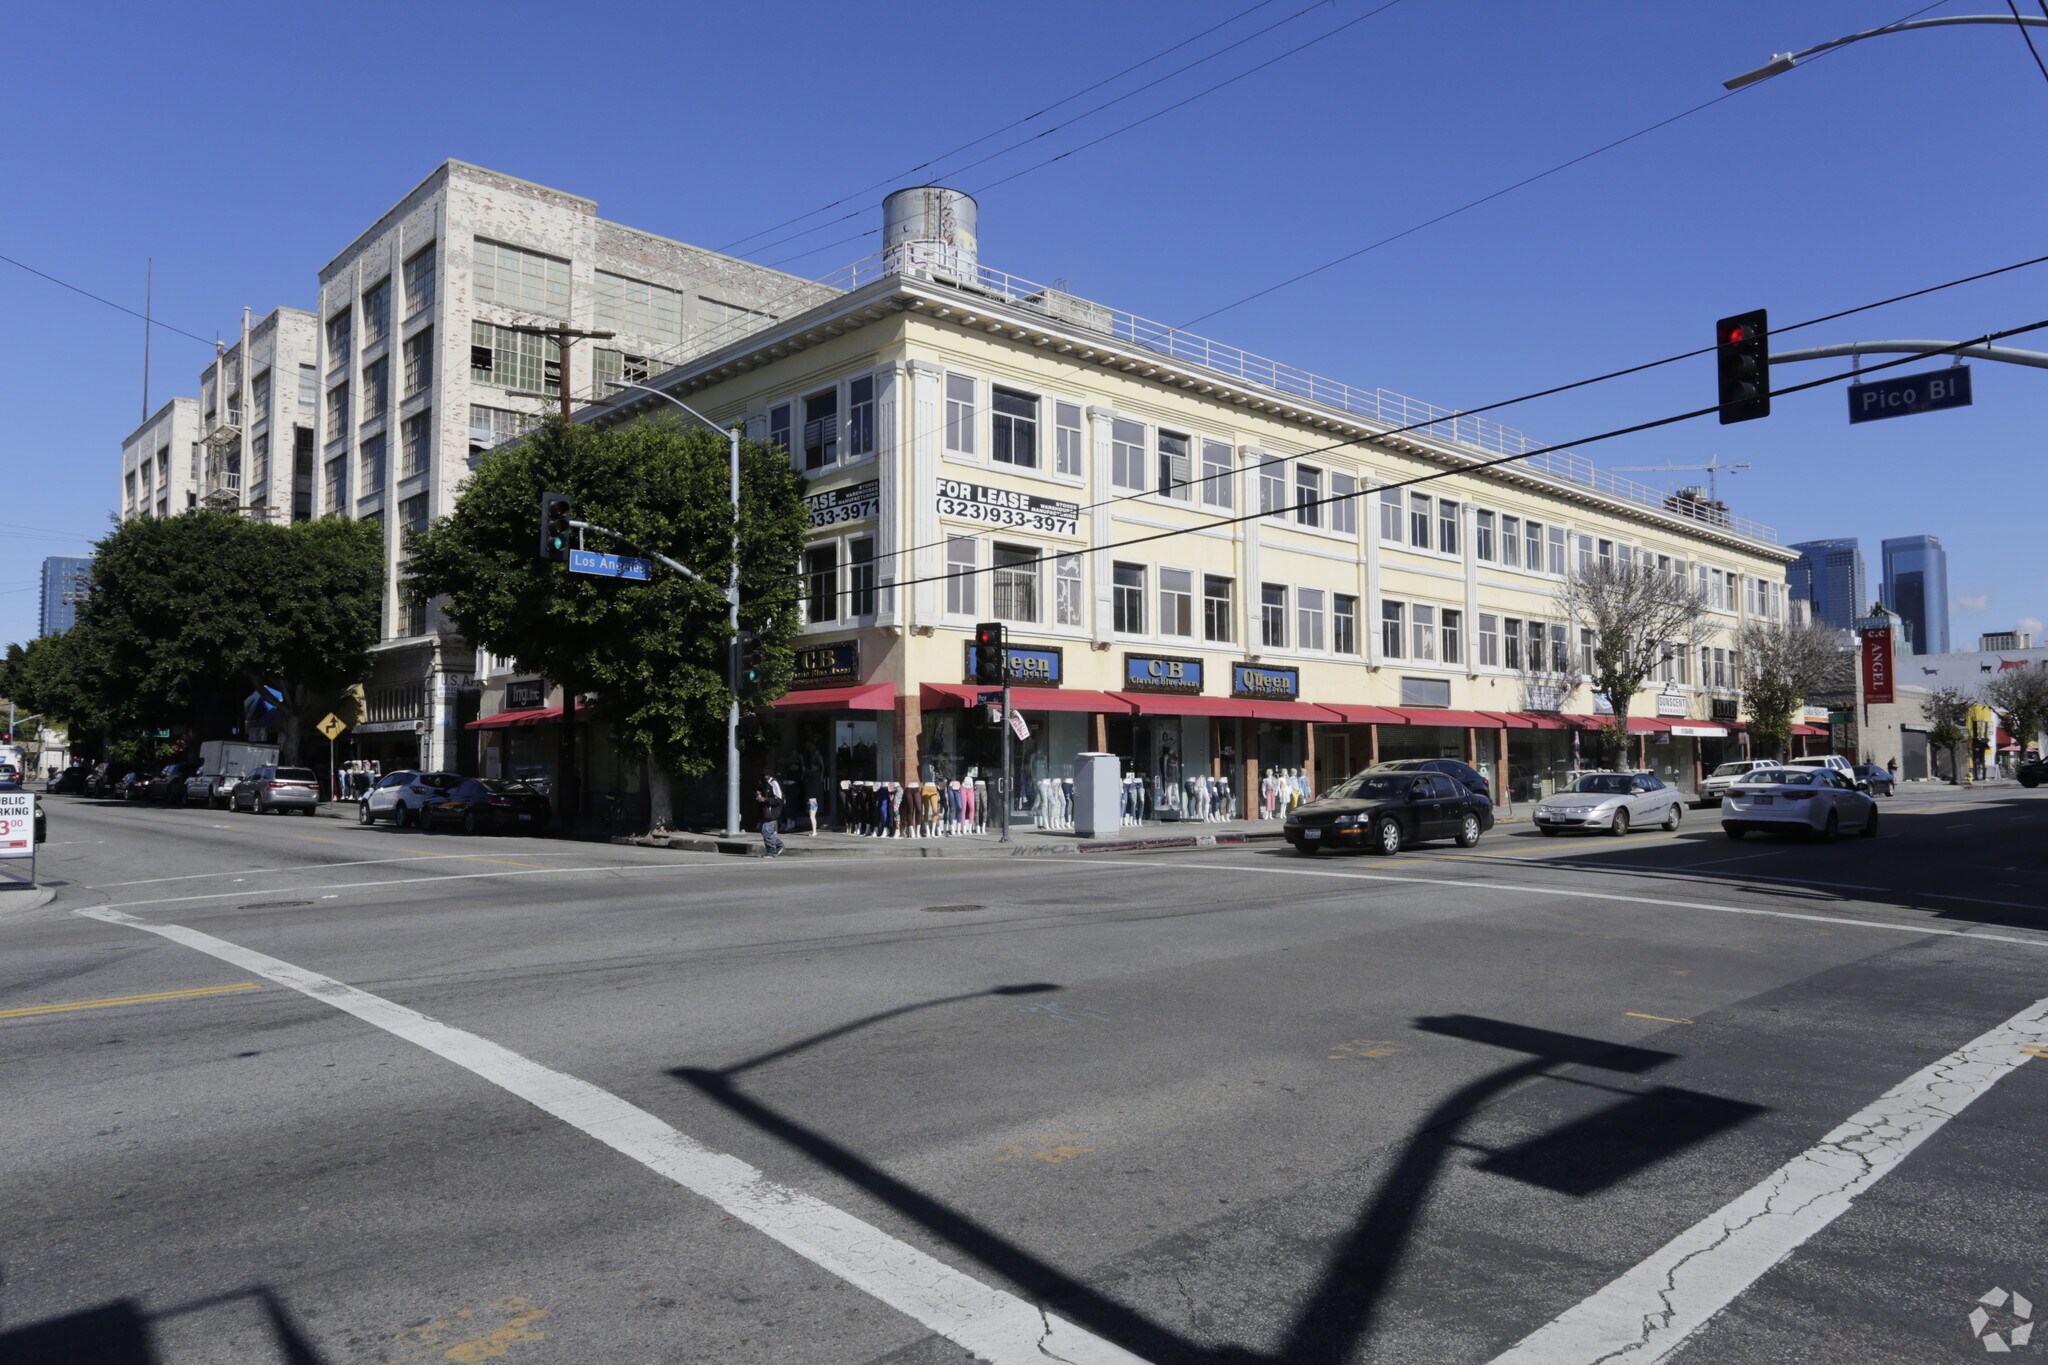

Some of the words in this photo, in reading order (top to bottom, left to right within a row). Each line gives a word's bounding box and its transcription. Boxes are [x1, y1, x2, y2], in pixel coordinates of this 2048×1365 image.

[1862, 388, 1917, 411] Pico
[1929, 378, 1955, 400] Bl
[936, 479, 972, 500] FOR
[977, 486, 1030, 511] LEASE
[1056, 501, 1077, 510] STORES
[936, 498, 1077, 535] (323)933-3971
[575, 554, 595, 567] Los
[599, 557, 646, 574] Angeles
[1001, 656, 1049, 671] een
[1871, 643, 1884, 690] ANGEL
[1131, 676, 1159, 685] Classic
[1178, 679, 1200, 687] Jeans
[1659, 697, 1685, 708] SUNSCENT
[0, 797, 25, 805] BLIC
